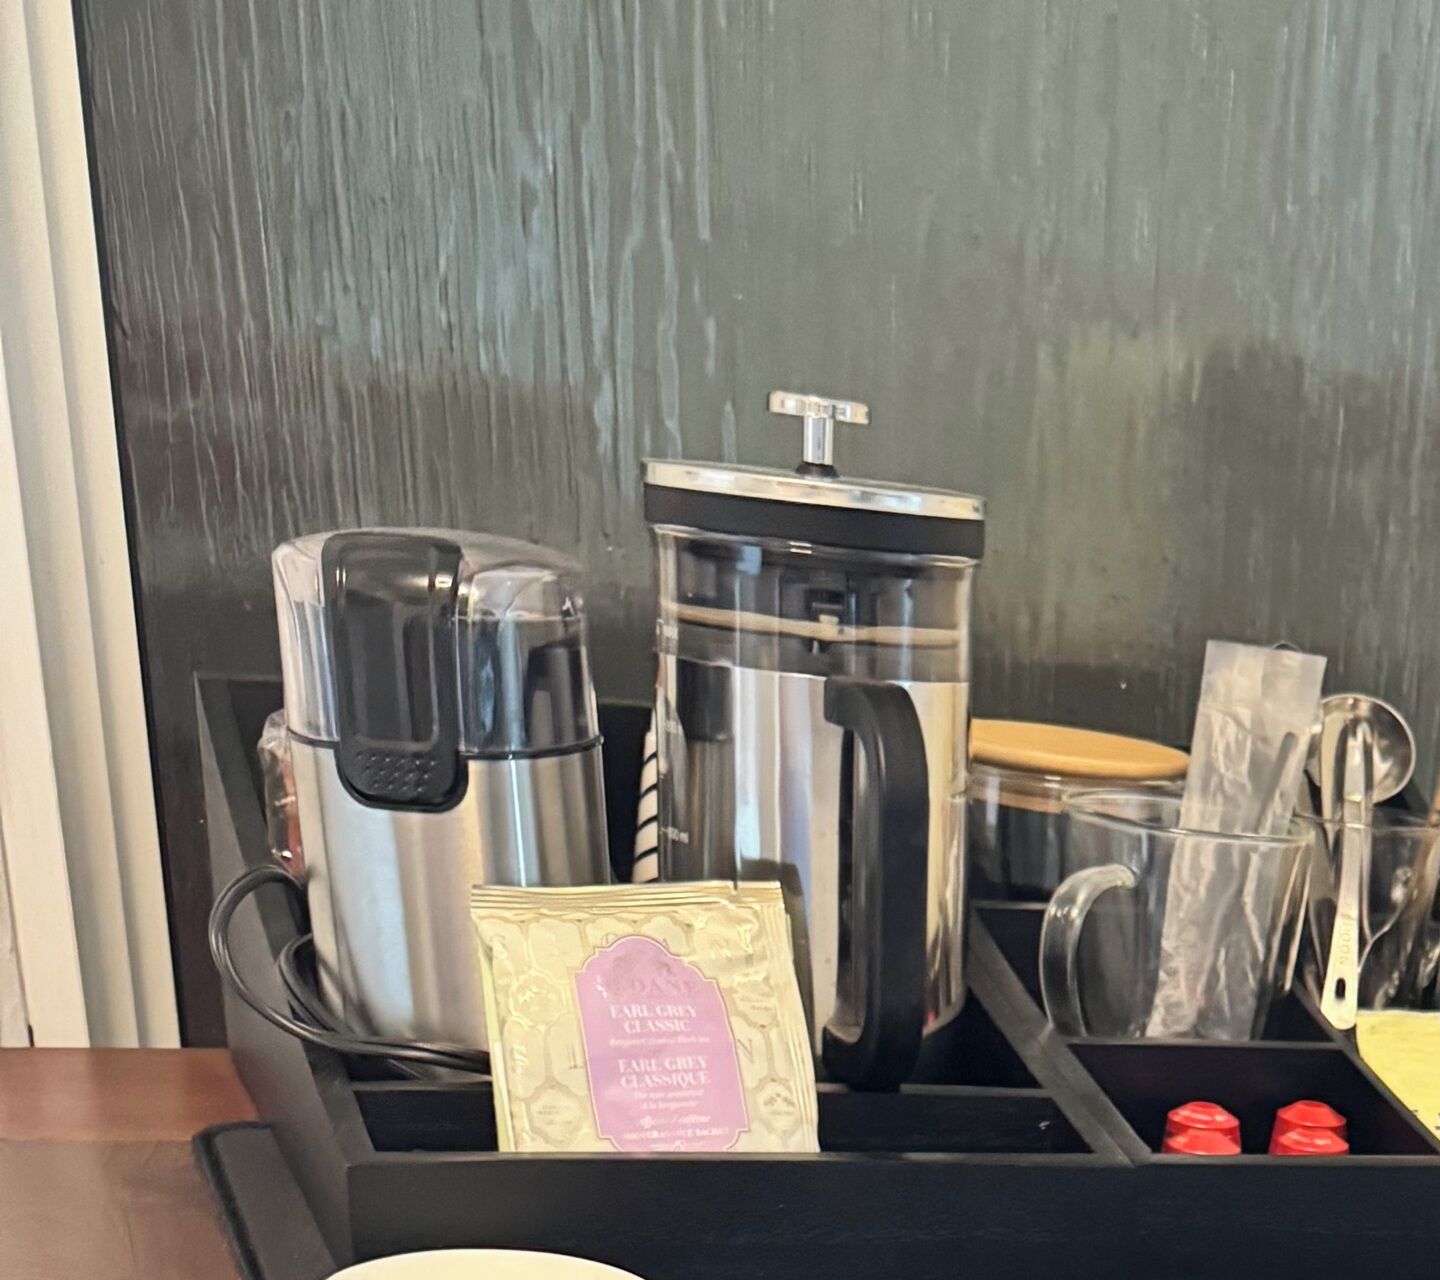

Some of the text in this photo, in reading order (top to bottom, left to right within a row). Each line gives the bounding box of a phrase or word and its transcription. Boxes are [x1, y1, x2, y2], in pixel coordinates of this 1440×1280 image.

[609, 1004, 697, 1020] EARL GREY
[624, 1019, 690, 1034] CLASSIC
[618, 1056, 708, 1073] EARL GREY
[621, 1071, 712, 1089] CLASSIQUE
